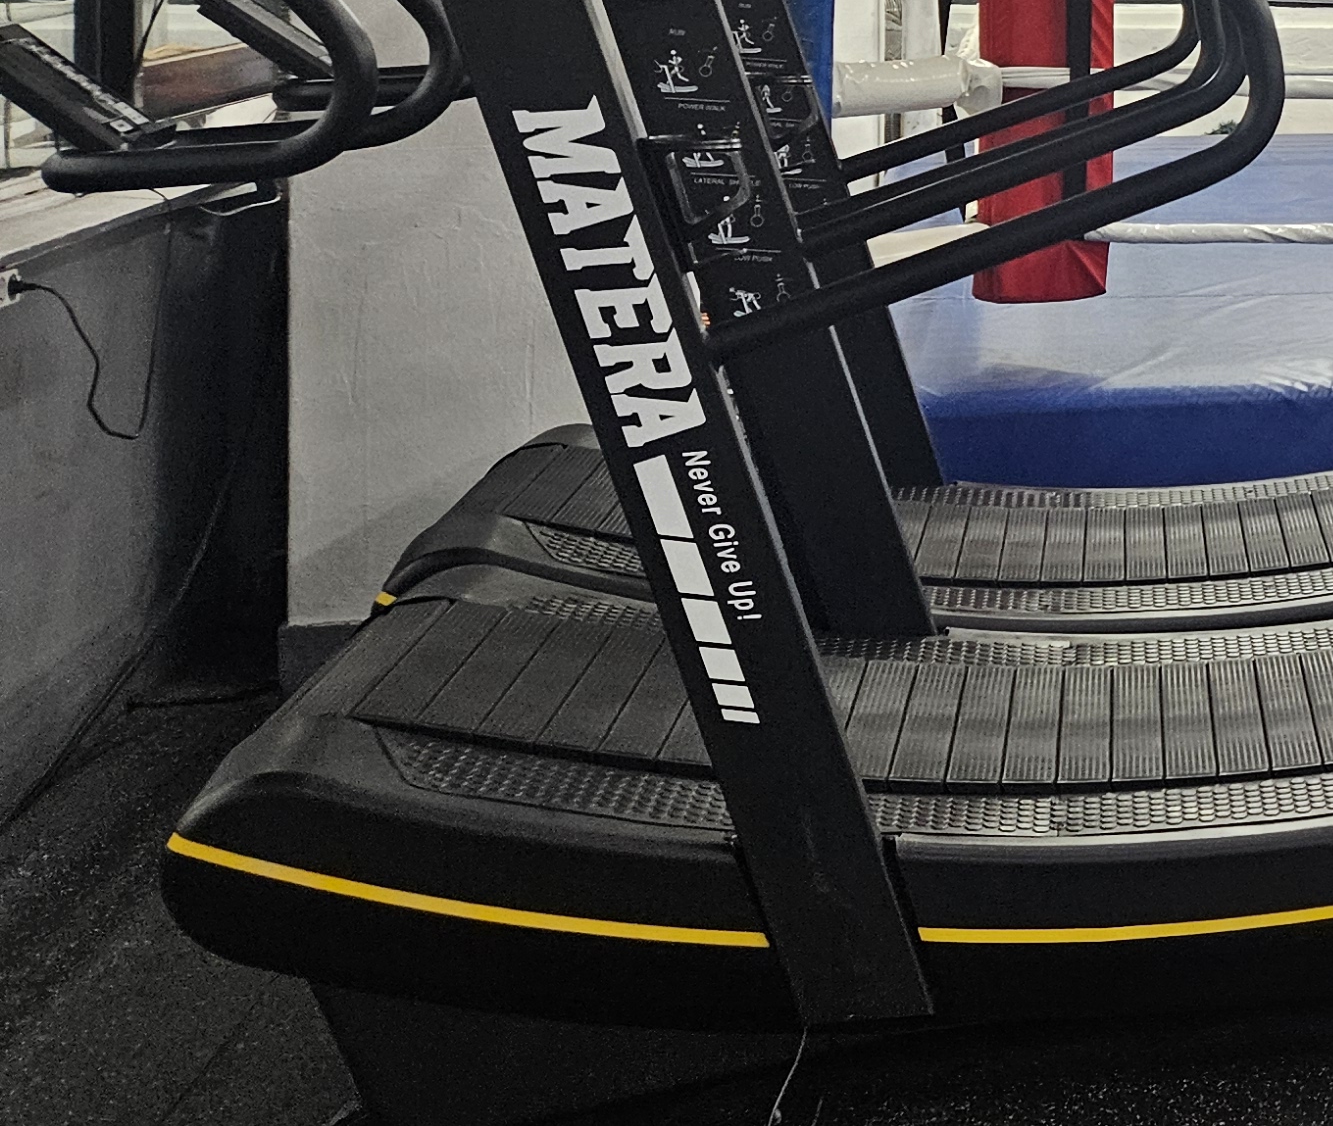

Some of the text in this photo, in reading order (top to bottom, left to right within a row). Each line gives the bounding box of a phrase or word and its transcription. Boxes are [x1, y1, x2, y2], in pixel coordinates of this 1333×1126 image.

[694, 177, 725, 185] LATERAL
[512, 95, 706, 448] MATERA
[682, 450, 762, 621] Never Give Up!
